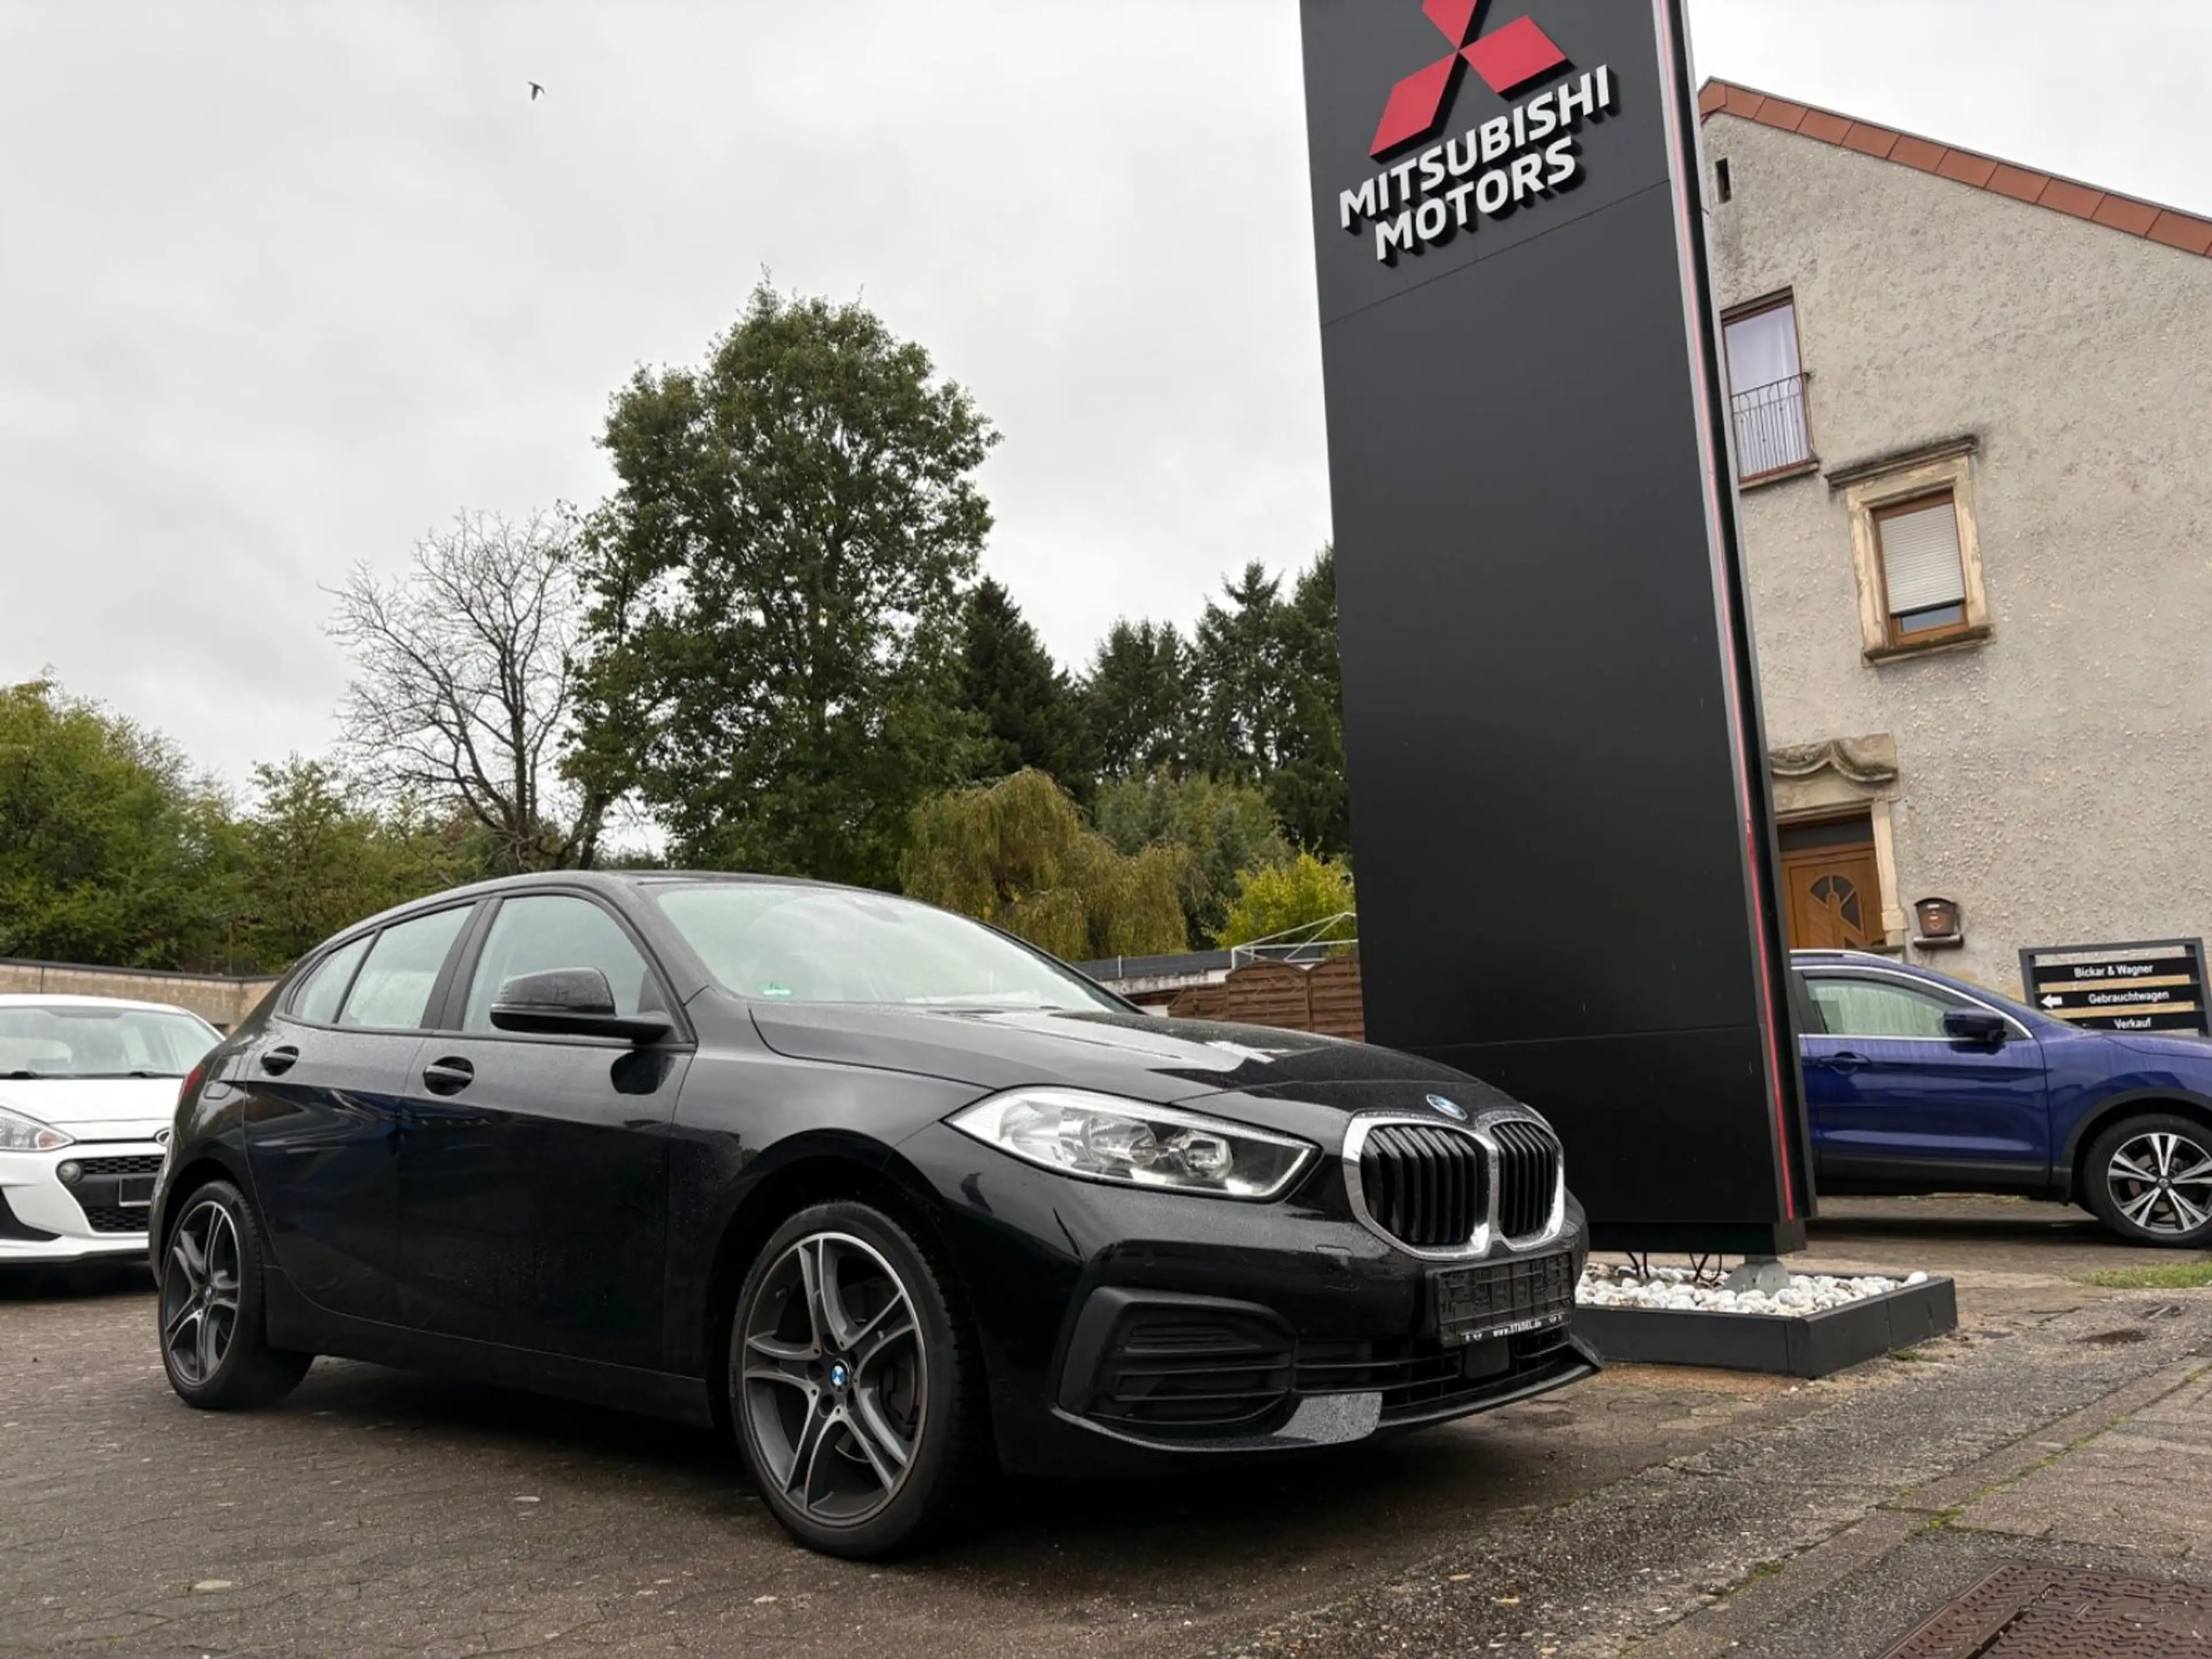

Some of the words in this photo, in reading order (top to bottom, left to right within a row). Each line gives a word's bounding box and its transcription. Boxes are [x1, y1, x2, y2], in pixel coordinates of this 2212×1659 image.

[1339, 64, 1610, 228] MITSUBISHI
[1375, 137, 1576, 261] MOTORS
[2108, 965, 2115, 976] &
[2117, 964, 2153, 976] Wagner
[2088, 991, 2170, 1004] Gebrauchtwagen
[2113, 1017, 2152, 1029] Verkauf
